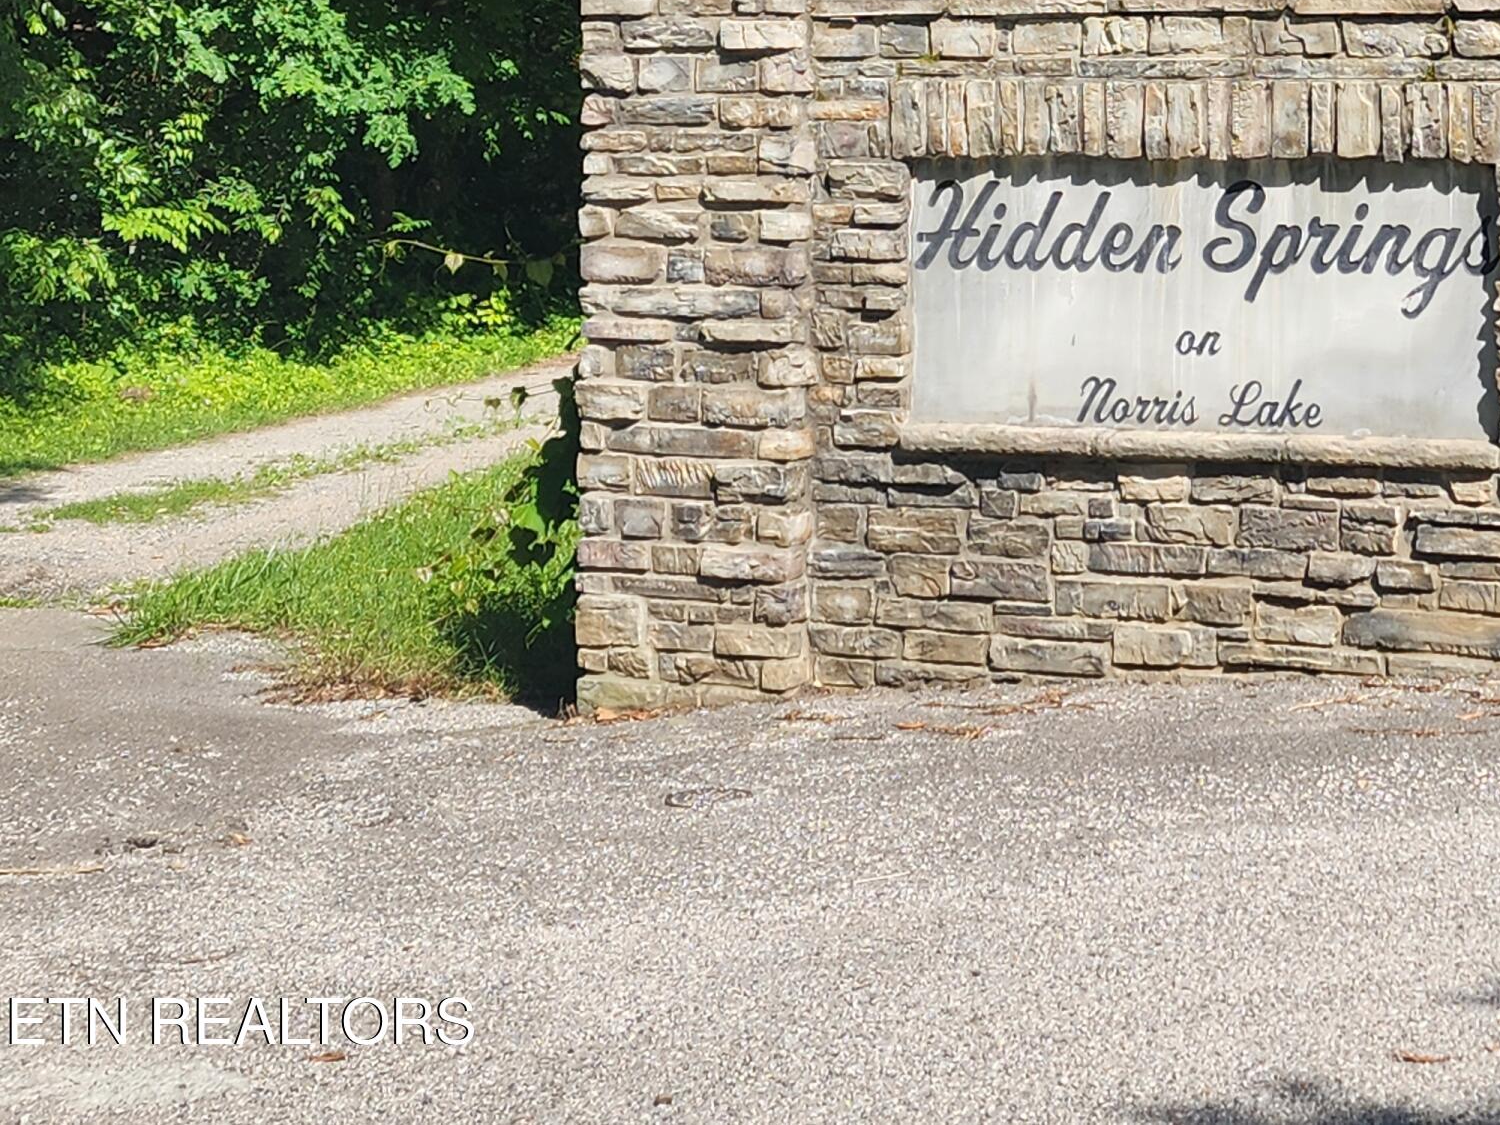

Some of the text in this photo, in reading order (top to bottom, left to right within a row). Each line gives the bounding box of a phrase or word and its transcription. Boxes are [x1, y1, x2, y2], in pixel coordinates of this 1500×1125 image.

[916, 180, 1499, 320] Hidden Springs
[1175, 328, 1221, 356] on
[1077, 376, 1323, 429] Norris Lake
